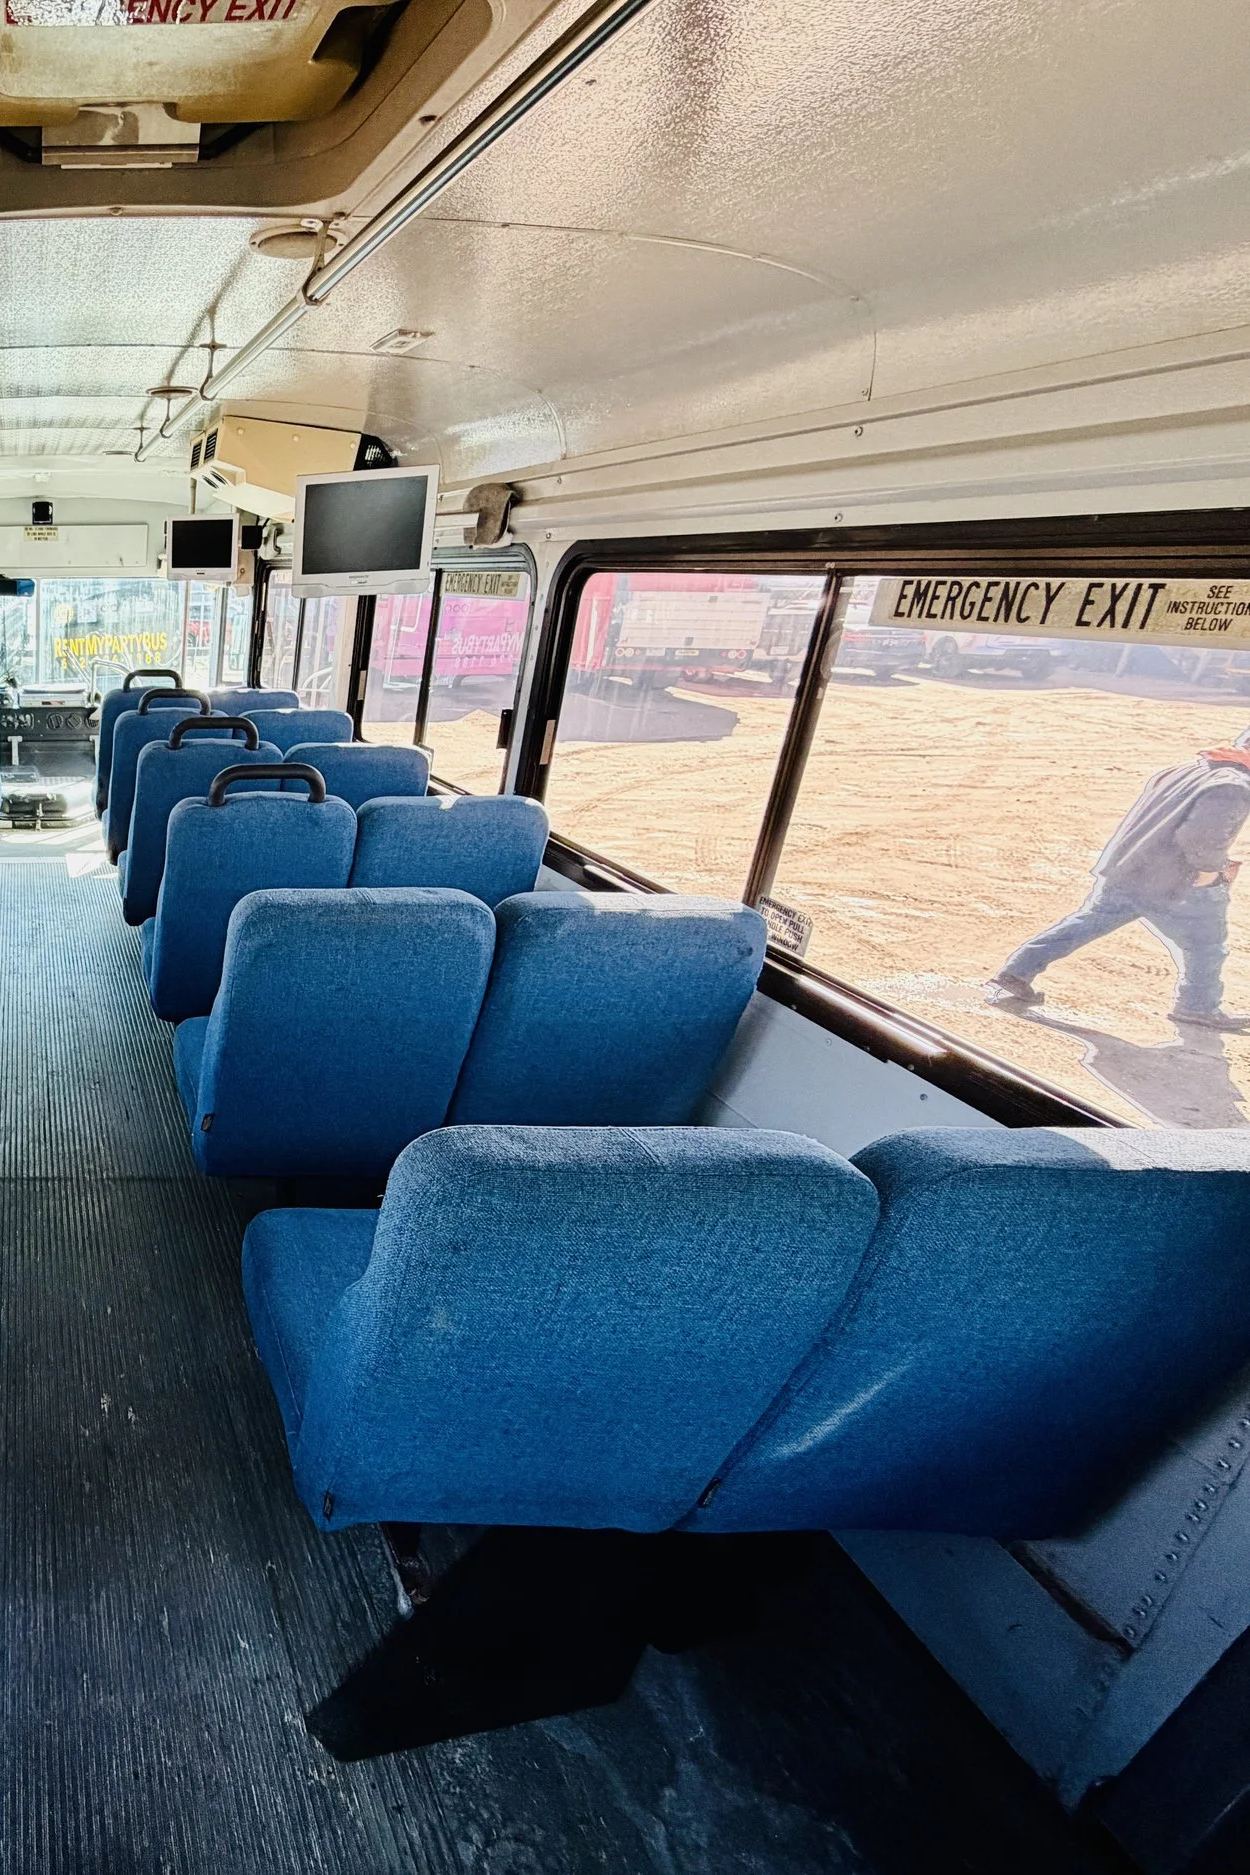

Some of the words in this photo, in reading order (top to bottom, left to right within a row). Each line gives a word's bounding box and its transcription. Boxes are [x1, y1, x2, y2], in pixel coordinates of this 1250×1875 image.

[224, 0, 297, 22] EXIT
[445, 573, 483, 593] EMERGENCY
[484, 574, 501, 595] EXIT
[1207, 585, 1234, 599] SEE
[894, 580, 1066, 625] EMERGENCY
[1075, 582, 1167, 630] EXIT
[1184, 617, 1233, 631] BELOW
[759, 896, 797, 919] EMERGENCY
[761, 907, 770, 917] TO
[770, 911, 788, 925] OPEN
[788, 920, 805, 935] PULL
[767, 920, 783, 934] NDLE
[784, 927, 803, 944] PUSH
[771, 934, 799, 951] WINDOW
